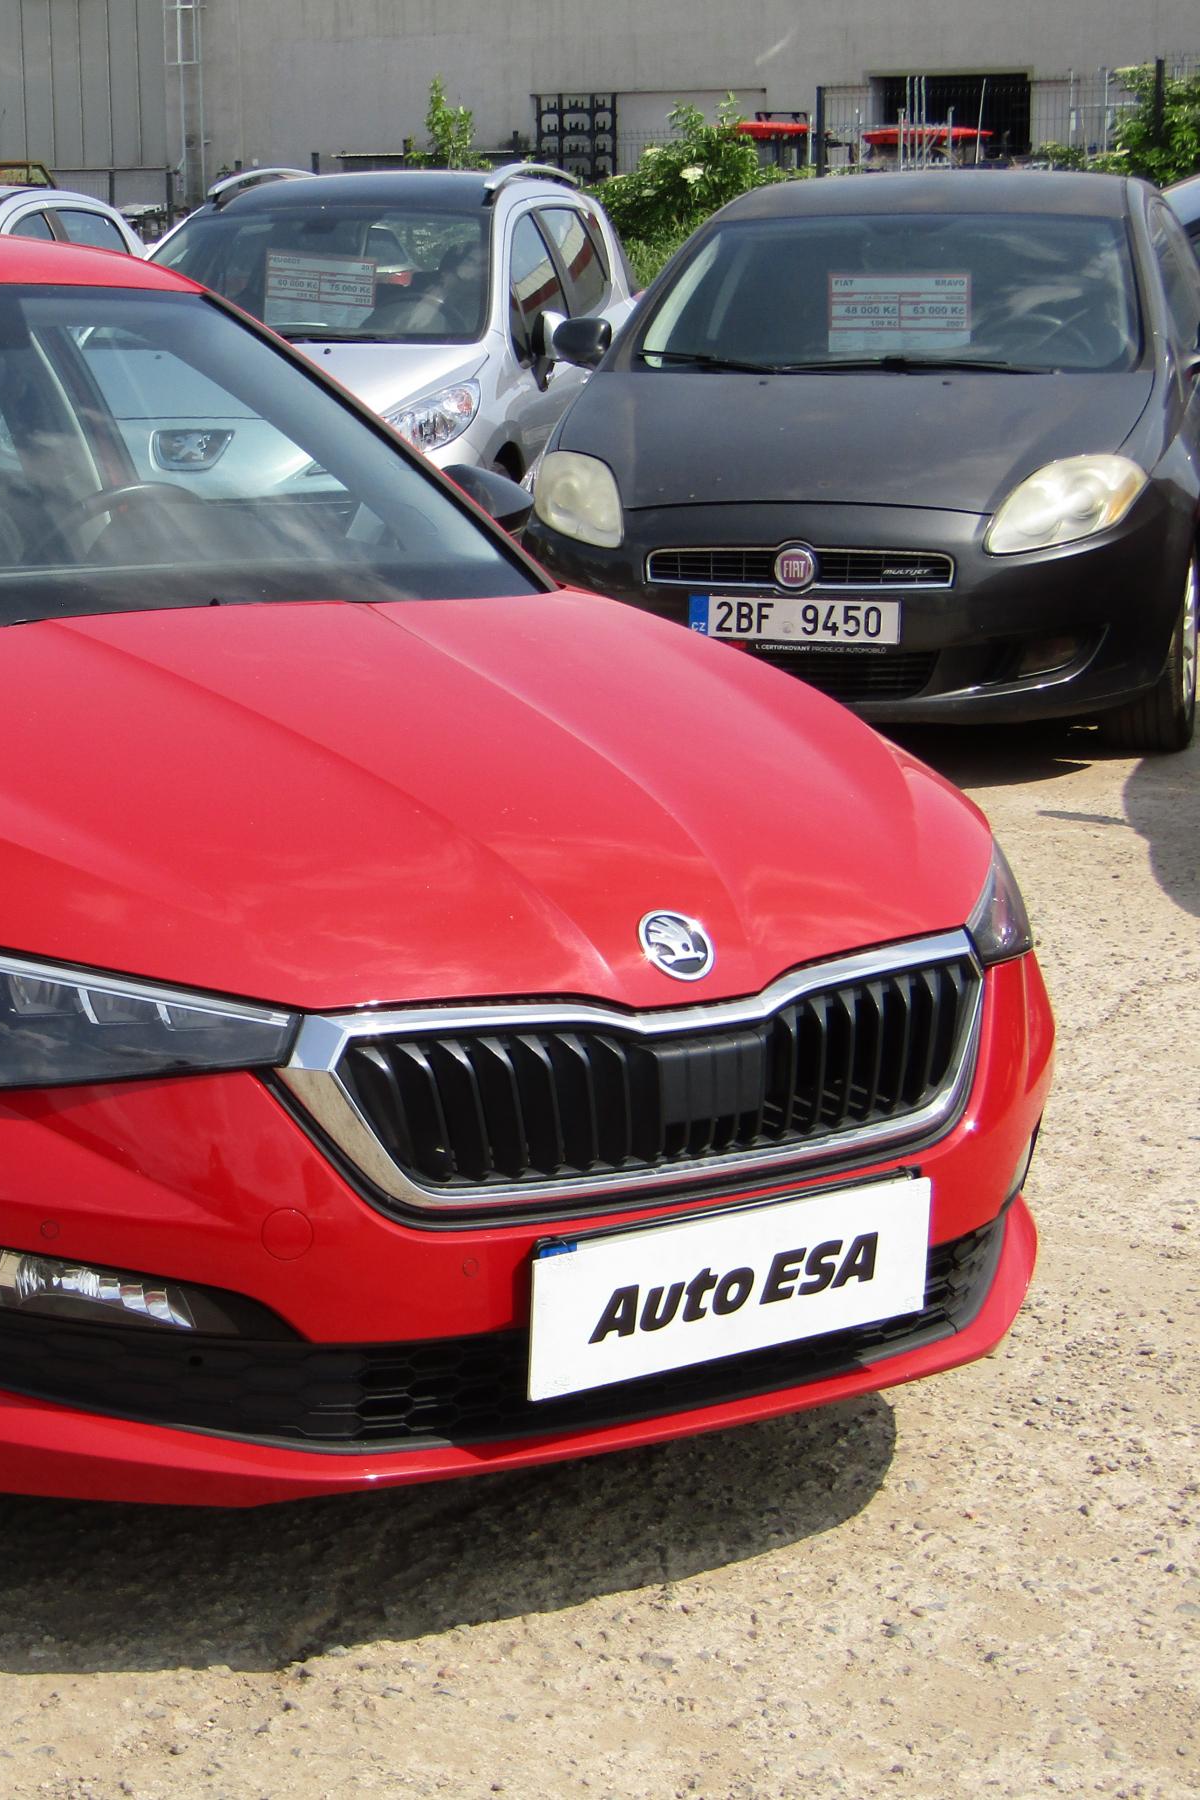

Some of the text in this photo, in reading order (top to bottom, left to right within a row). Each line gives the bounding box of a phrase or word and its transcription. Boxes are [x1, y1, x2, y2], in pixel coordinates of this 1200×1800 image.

[845, 305, 897, 315] 48 000 Kč
[913, 305, 965, 315] 63 000 Kč
[783, 560, 806, 578] FIAT
[882, 568, 931, 576] MULTIJET
[715, 601, 882, 638] 2BF 9450
[691, 621, 706, 632] CZ
[588, 1231, 879, 1345] Auto ESA
